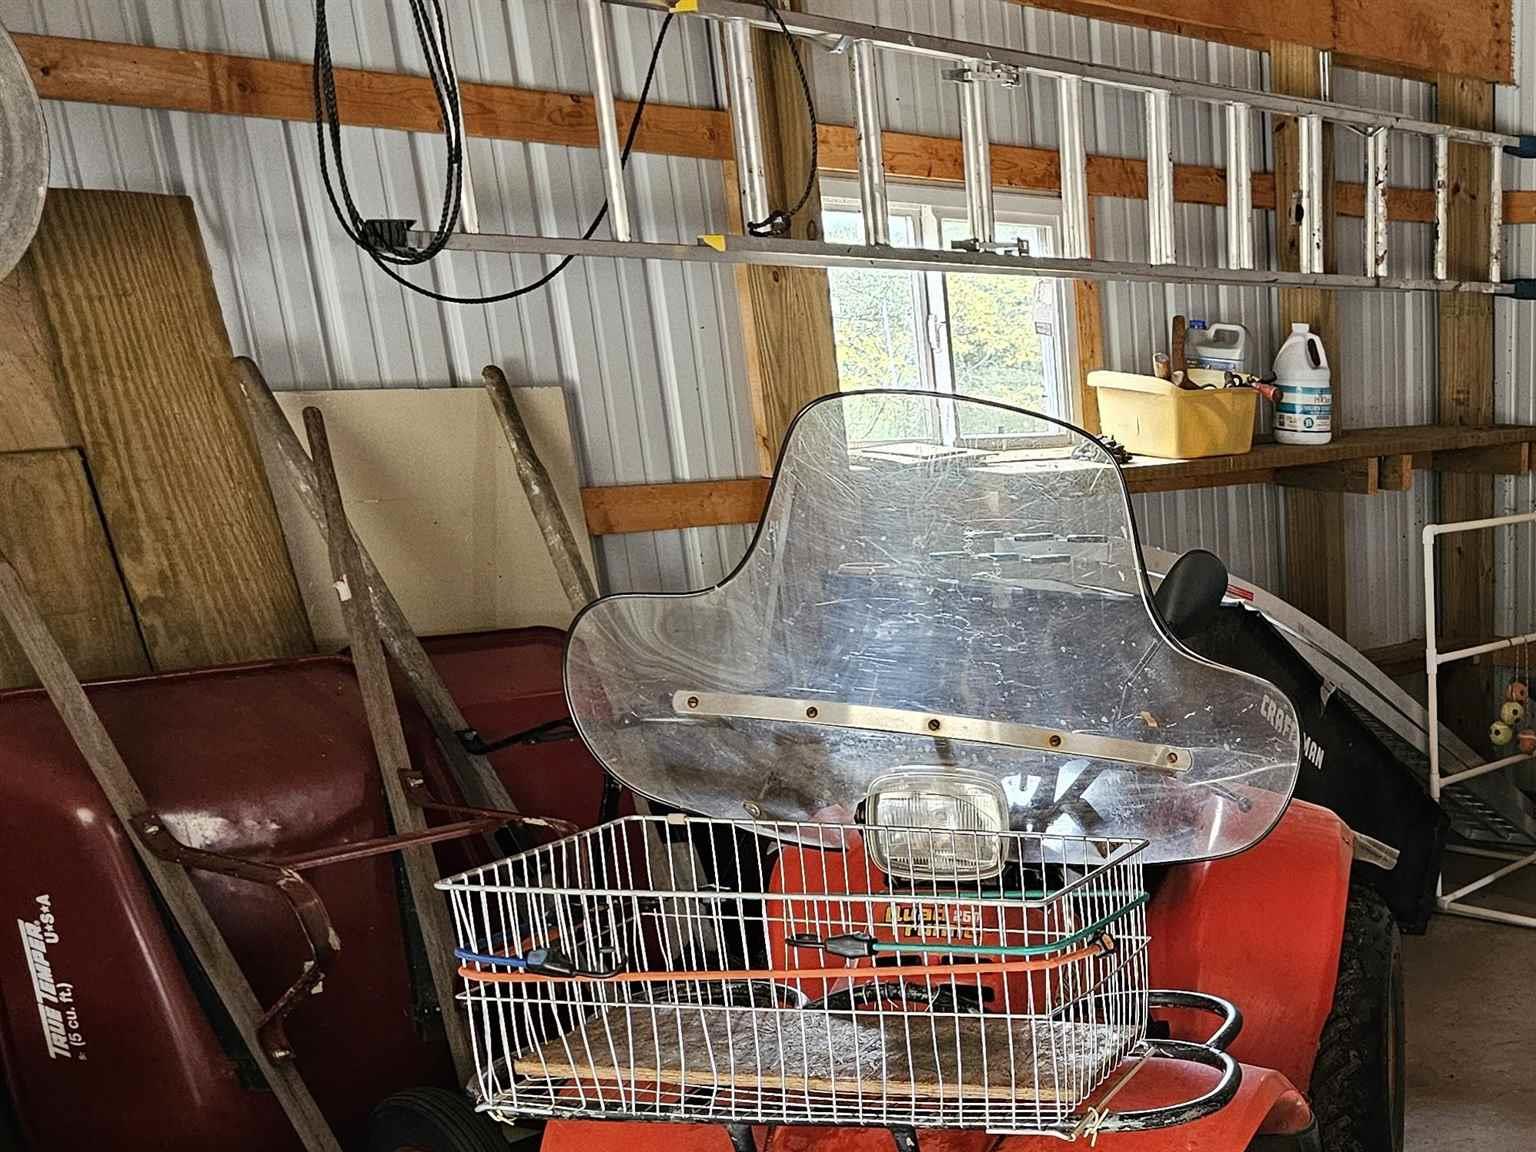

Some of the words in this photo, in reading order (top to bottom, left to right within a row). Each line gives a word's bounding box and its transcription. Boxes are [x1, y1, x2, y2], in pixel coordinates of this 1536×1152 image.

[17, 918, 59, 1004] TEMPER
[37, 1002, 73, 1059] TRUE
[66, 1006, 80, 1029] cu.
